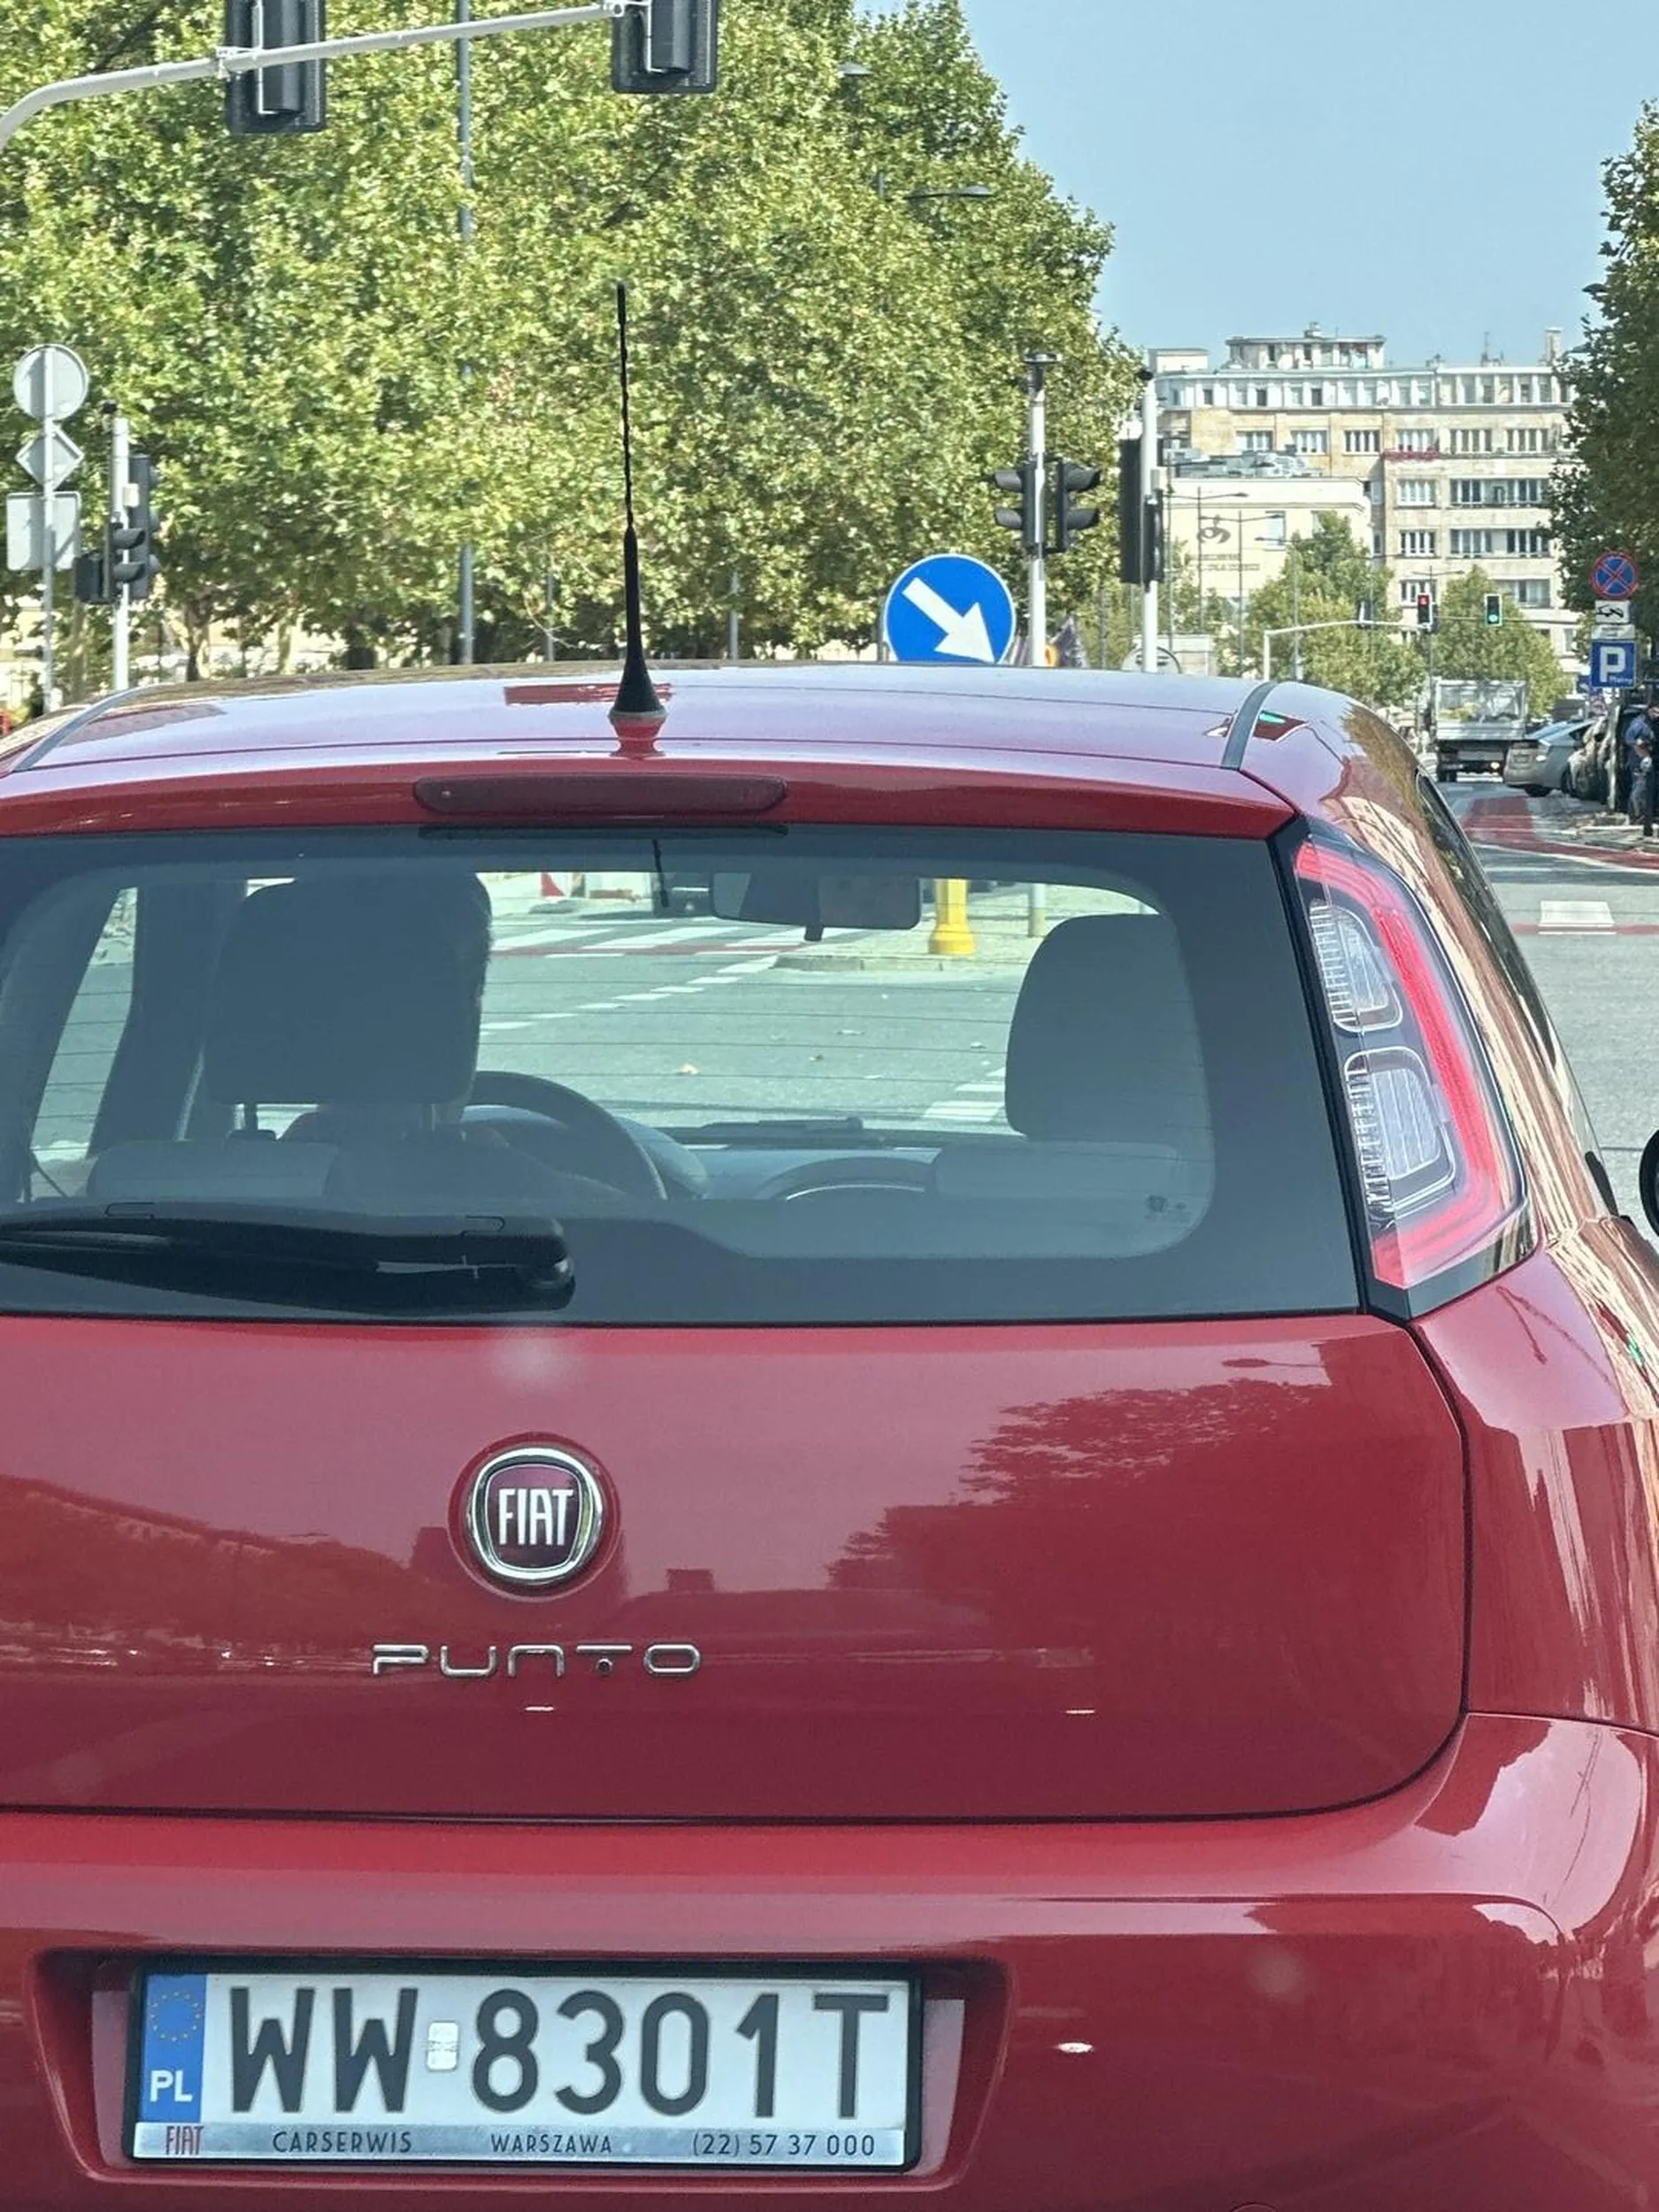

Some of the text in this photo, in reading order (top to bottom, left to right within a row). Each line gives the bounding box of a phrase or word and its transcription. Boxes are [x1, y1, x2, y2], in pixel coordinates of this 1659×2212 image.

[1600, 646, 1625, 682] P
[498, 1488, 573, 1545] FIAT
[372, 1644, 701, 1677] PUNTO
[230, 1987, 889, 2118] WW 8301T
[150, 2070, 193, 2101] PL
[165, 2125, 204, 2155] FIAT
[273, 2131, 411, 2153] CARSERWIS
[491, 2133, 612, 2154] WARSZAWA
[788, 2135, 816, 2155] 37
[826, 2135, 875, 2156] 000
